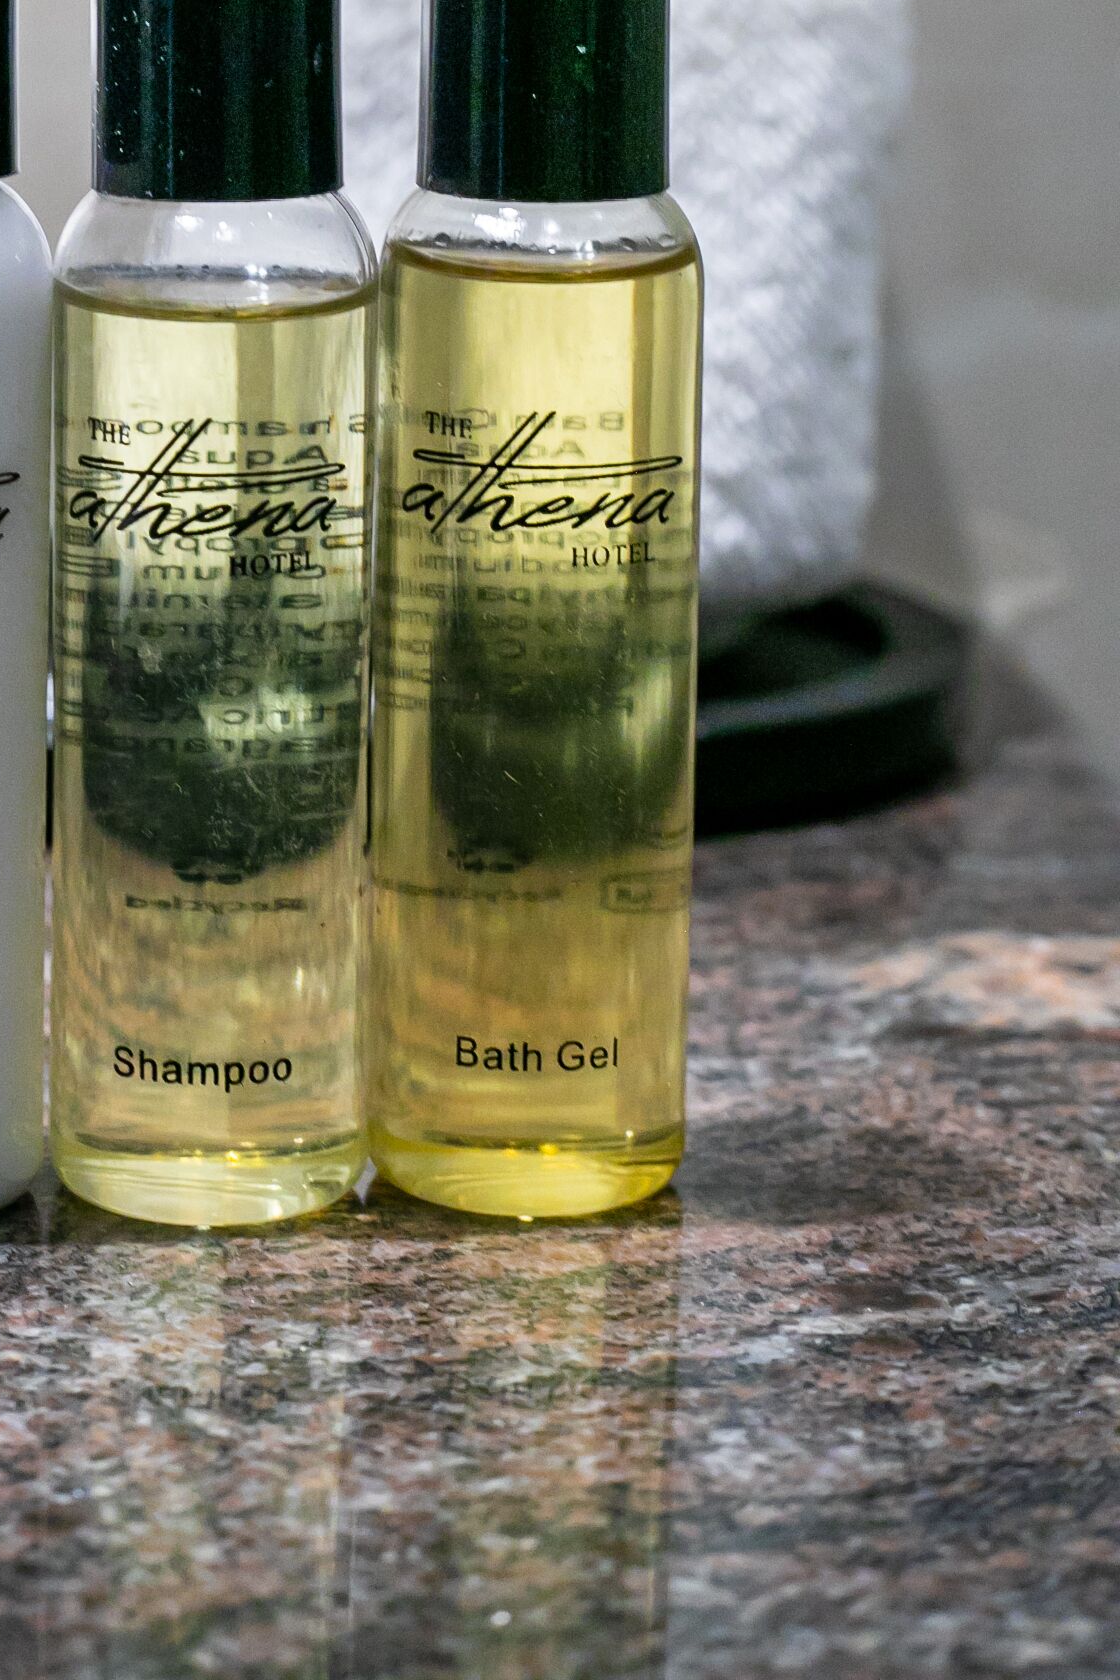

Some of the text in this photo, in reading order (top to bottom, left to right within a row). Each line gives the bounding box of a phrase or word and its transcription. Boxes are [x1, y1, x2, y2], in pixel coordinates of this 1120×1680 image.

[87, 417, 131, 445] THE
[423, 411, 473, 438] THE
[69, 418, 346, 543] athena
[401, 410, 682, 534] athena
[229, 550, 314, 578] HOTEL
[571, 542, 656, 570] HOTEL
[113, 1044, 293, 1094] Shampoo
[455, 1035, 618, 1072] Bath Gel
